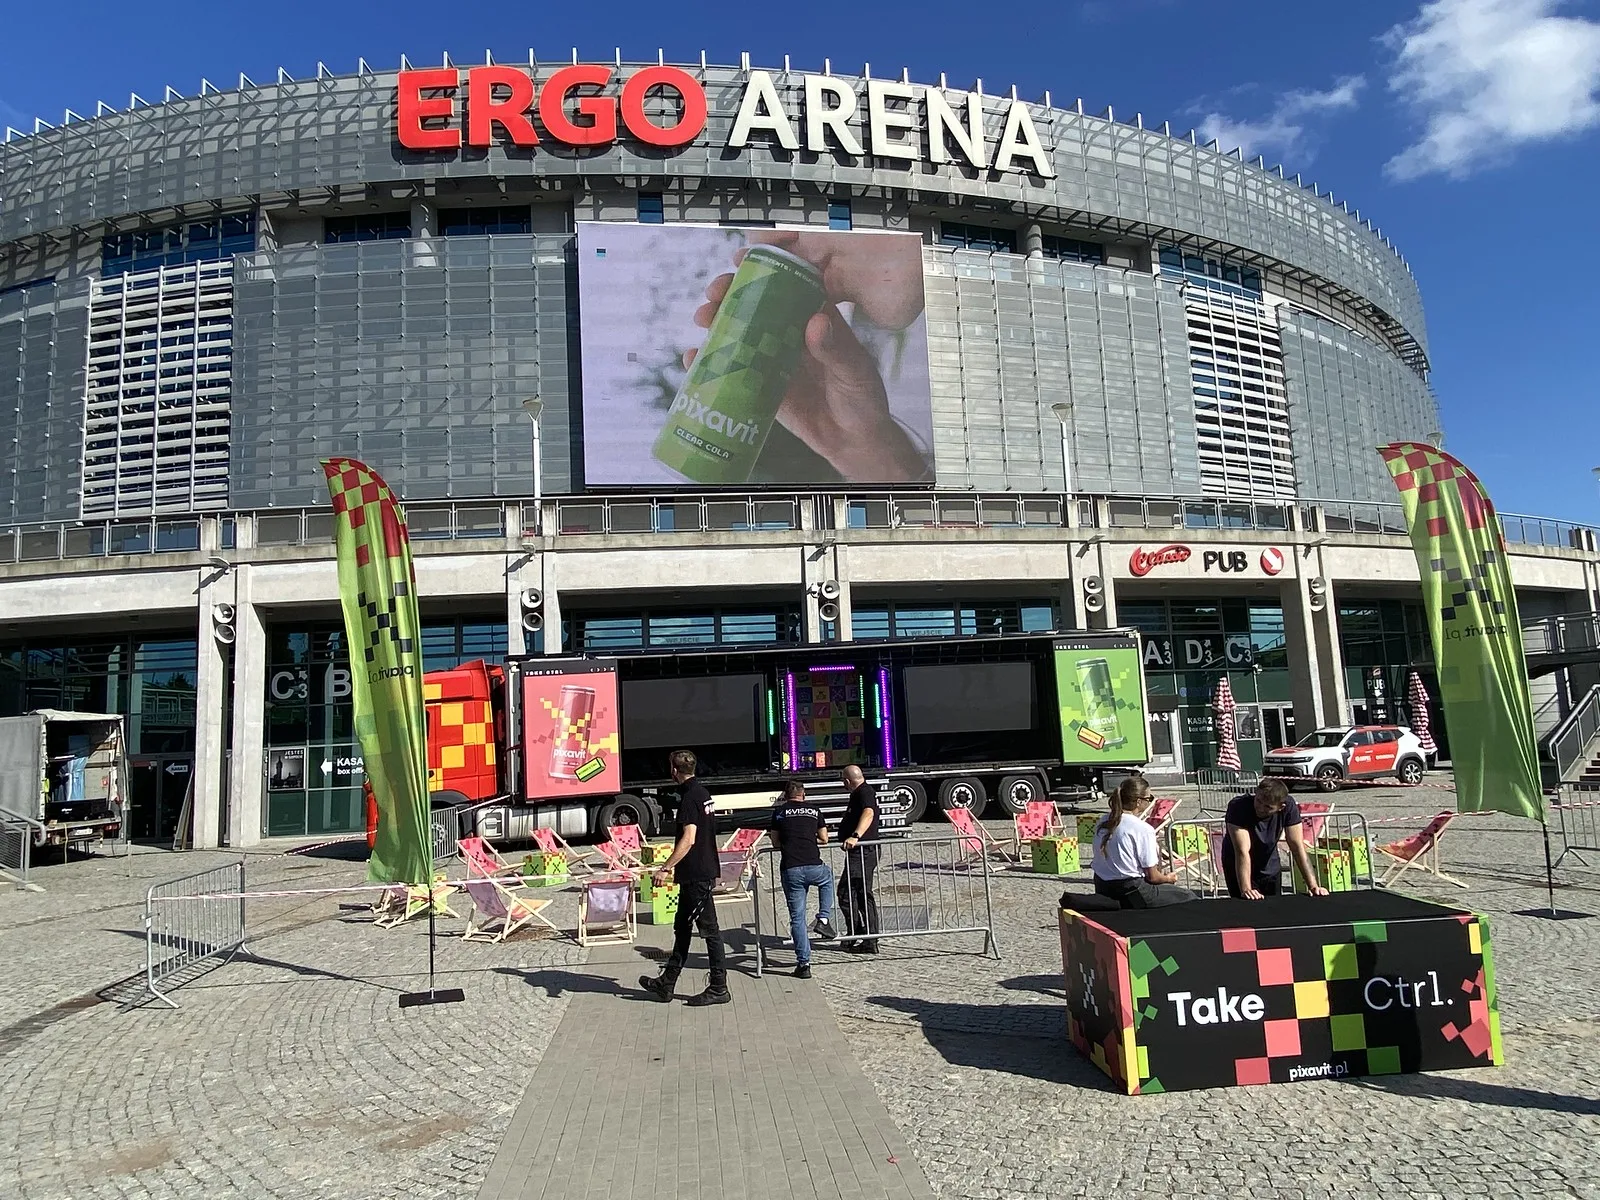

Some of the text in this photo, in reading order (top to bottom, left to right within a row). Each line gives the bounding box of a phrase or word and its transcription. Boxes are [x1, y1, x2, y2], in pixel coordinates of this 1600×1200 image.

[397, 65, 1055, 178] ERGO ARENA
[671, 391, 759, 445] pixavit
[676, 427, 704, 447] CLEAR
[705, 442, 730, 459] COLA
[1203, 550, 1248, 573] PUB
[1161, 712, 1169, 722] 3
[1187, 716, 1213, 725] KASA 2
[336, 757, 364, 767] KASA
[553, 749, 586, 759] pixavit
[1167, 971, 1454, 1027] Take Ctrl.
[1289, 1061, 1349, 1082] pixavit.pl
